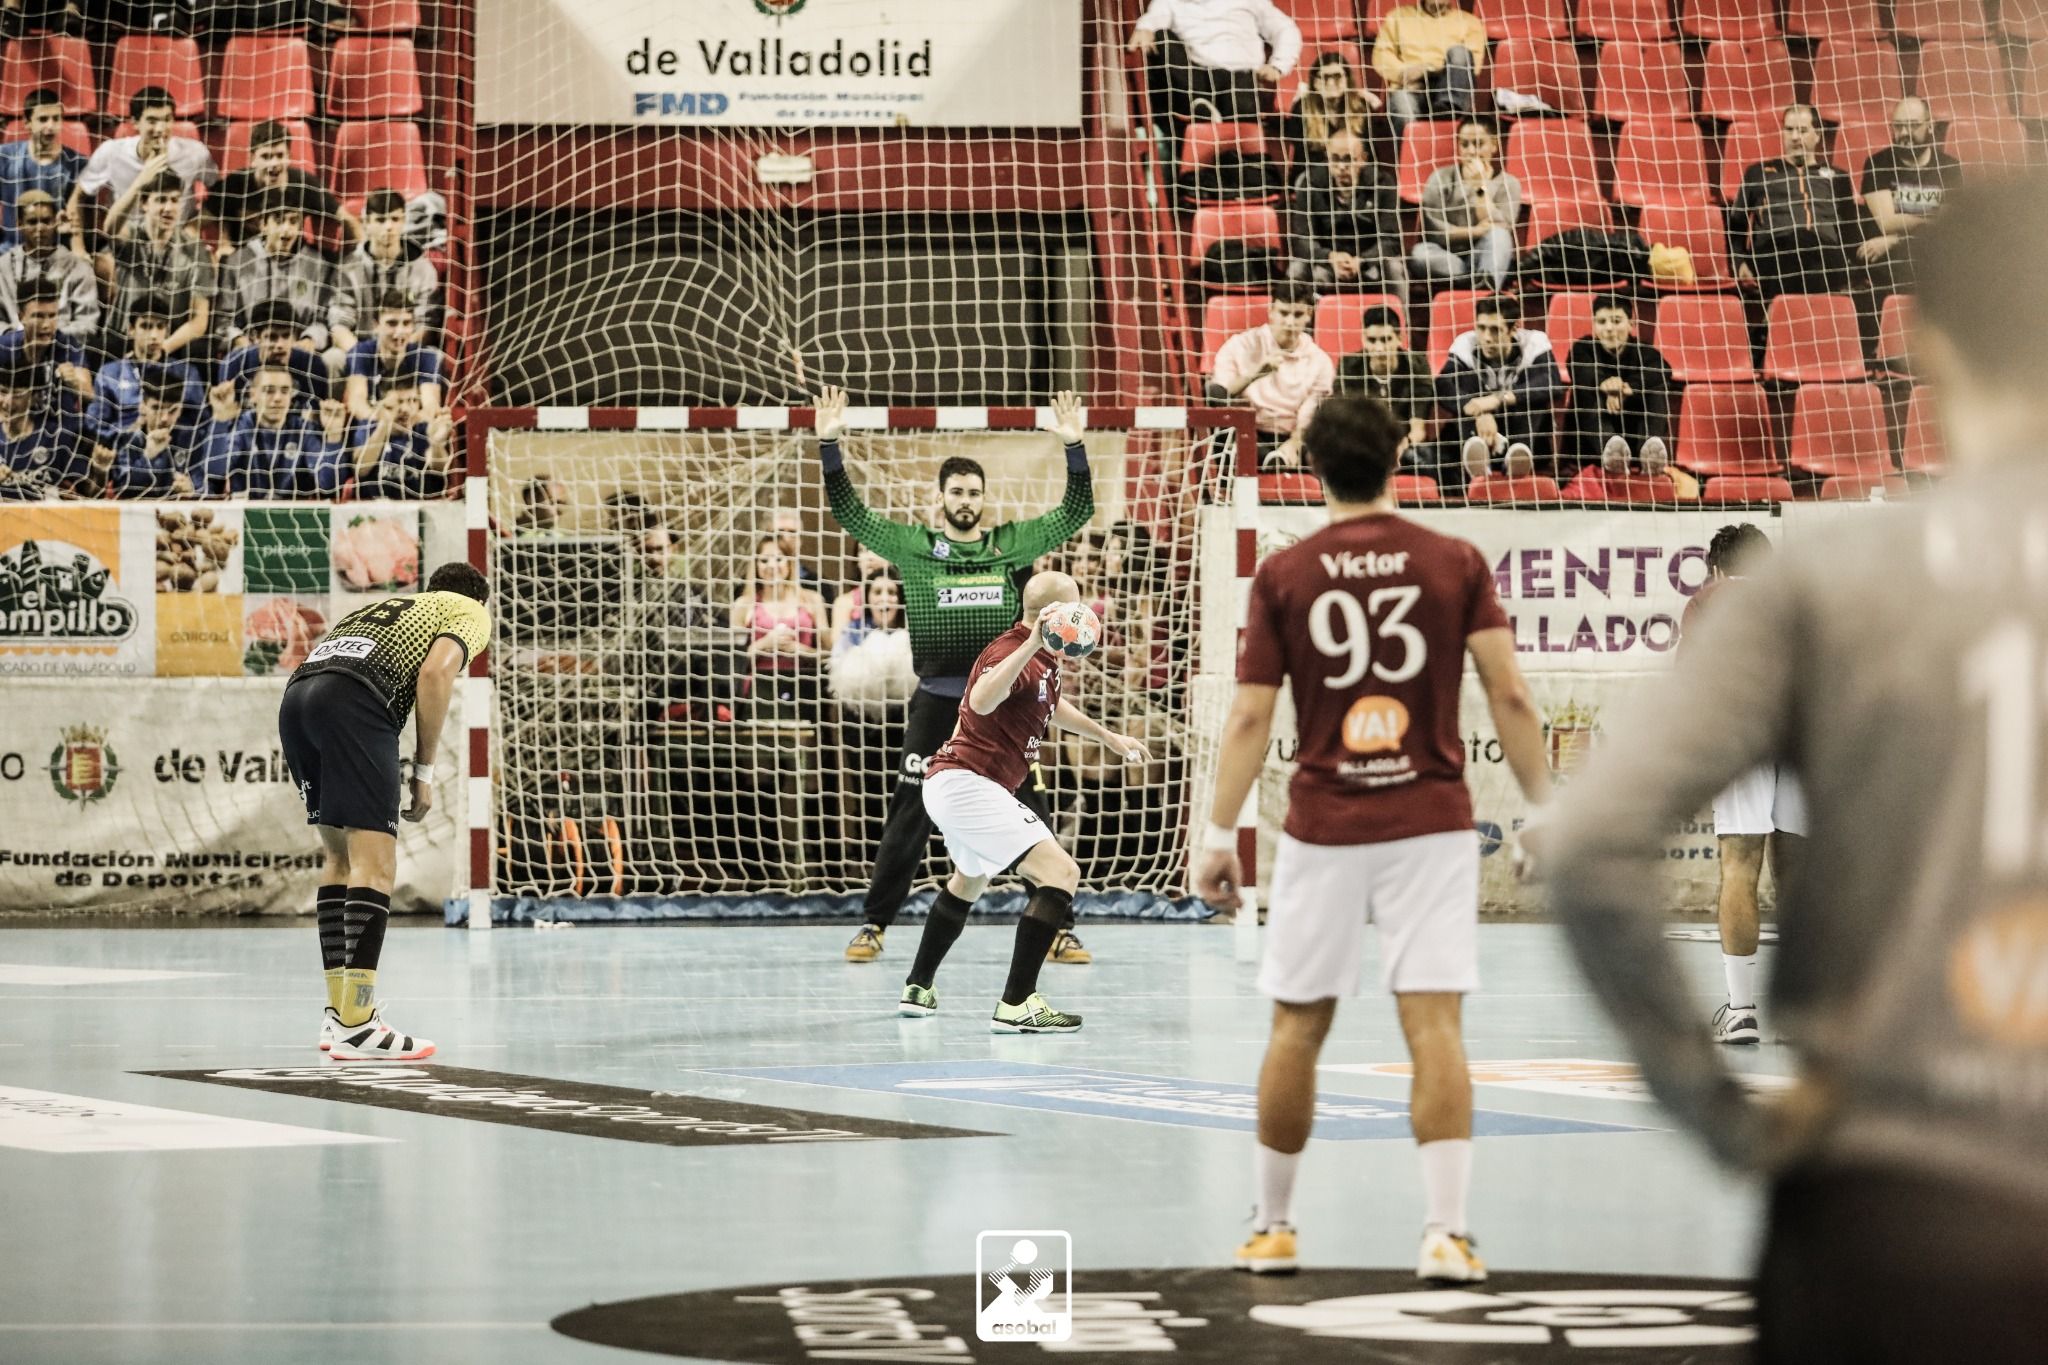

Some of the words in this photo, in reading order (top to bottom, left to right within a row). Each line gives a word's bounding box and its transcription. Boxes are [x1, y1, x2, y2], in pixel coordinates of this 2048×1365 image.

[627, 38, 679, 76] de
[698, 38, 932, 77] Valladolid
[634, 93, 730, 116] FMD
[1319, 550, 1410, 579] Víctor
[1494, 546, 1711, 600] MENTO
[22, 582, 47, 609] el
[954, 591, 1001, 603] MOYUA
[1308, 585, 1428, 690] 93
[1509, 612, 1681, 653] LLADO
[154, 748, 206, 784] de
[0, 849, 155, 869] Fundación
[165, 850, 327, 872] Municipal
[54, 871, 93, 888] de
